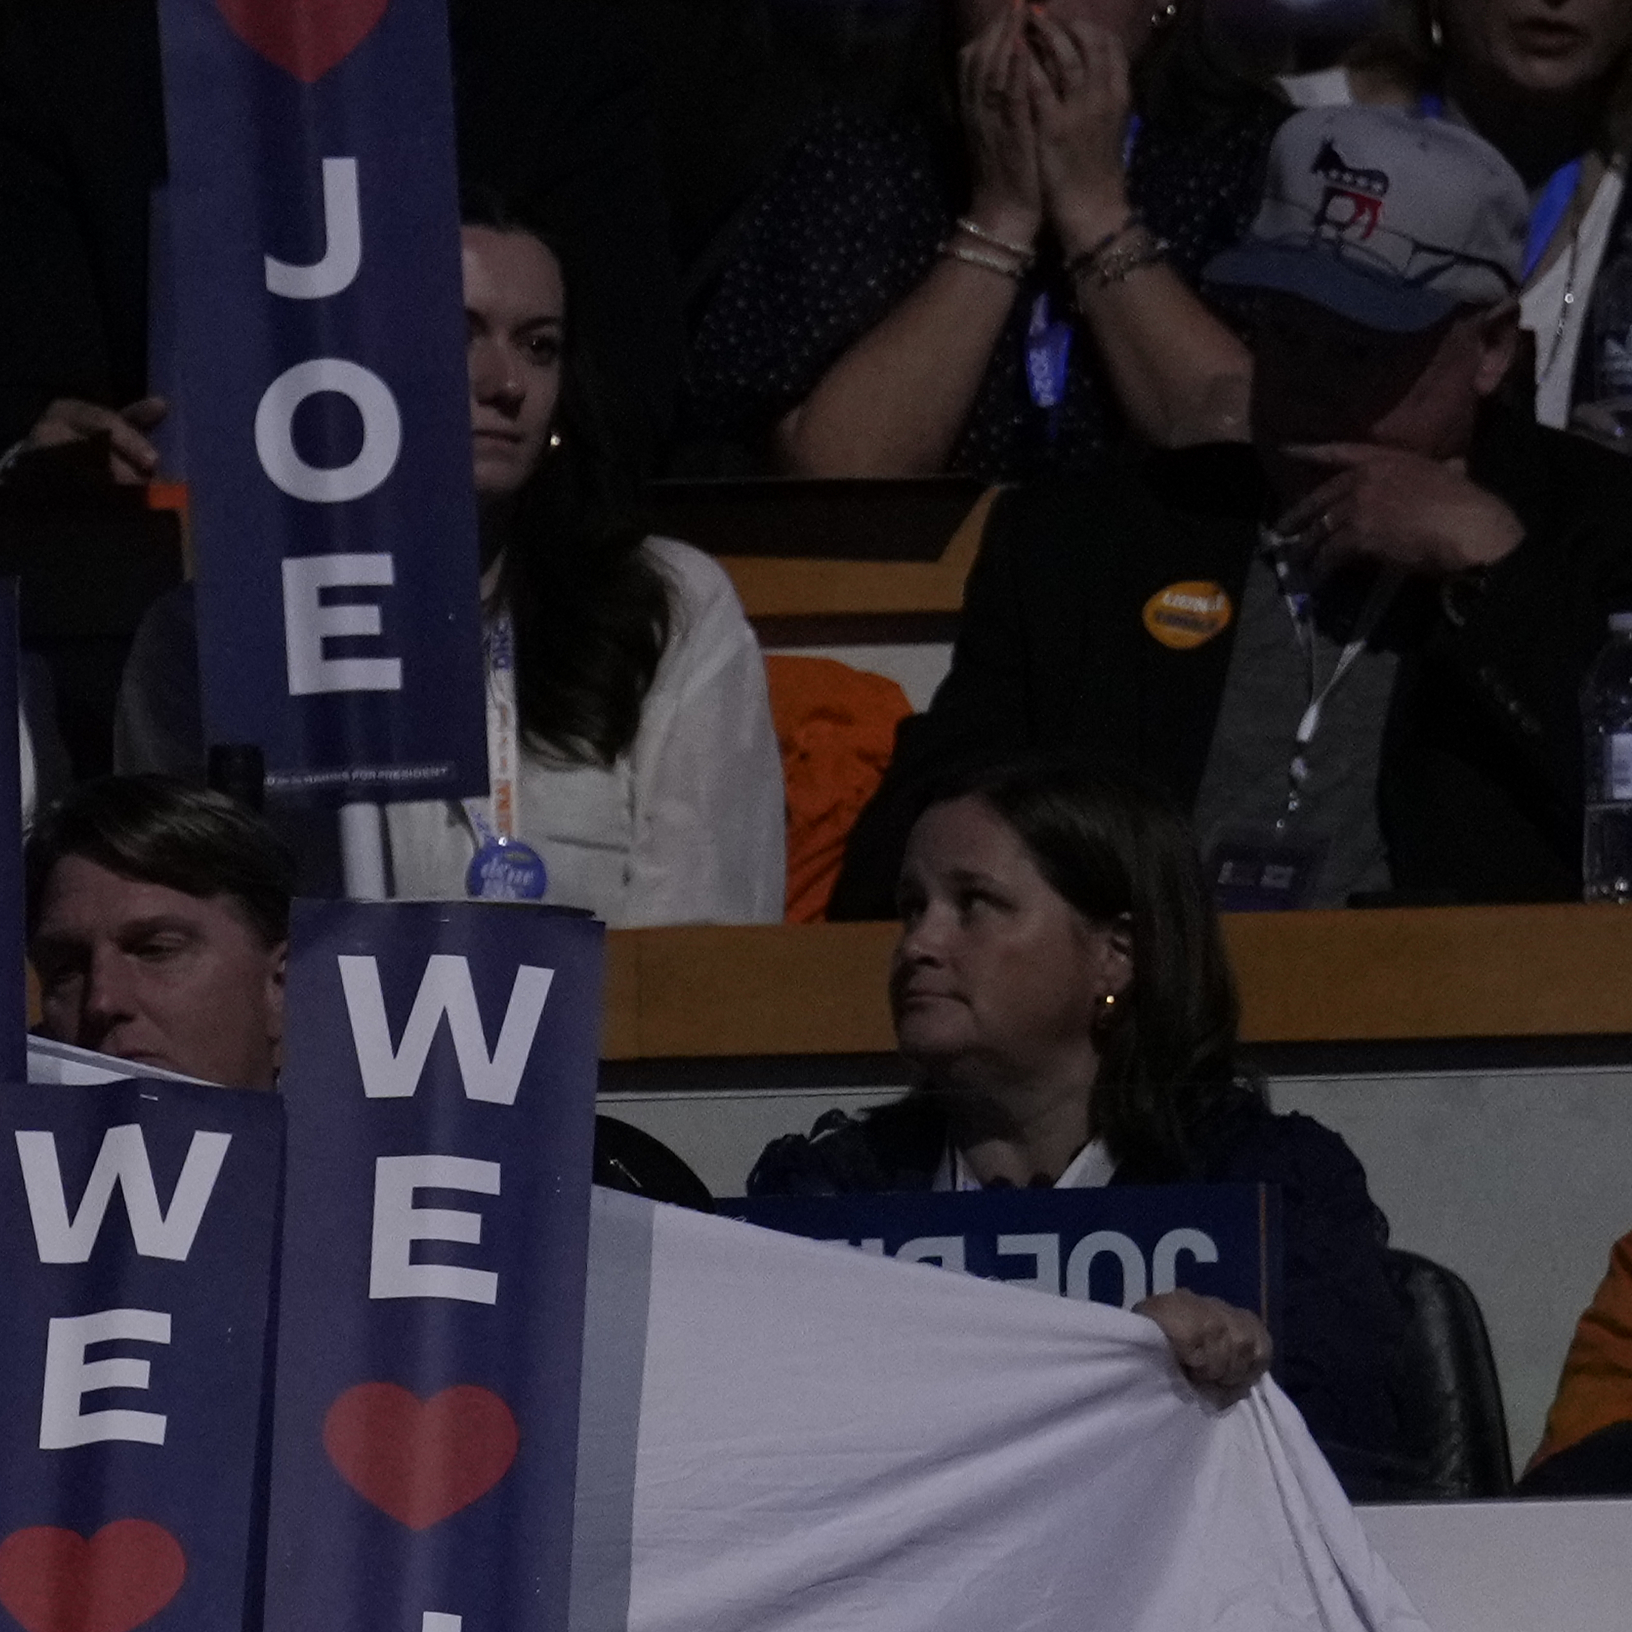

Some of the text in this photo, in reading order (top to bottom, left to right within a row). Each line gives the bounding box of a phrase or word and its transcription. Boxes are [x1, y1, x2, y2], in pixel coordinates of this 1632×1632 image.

[254, 158, 404, 697] JOE
[15, 1123, 232, 1450] WE
[338, 954, 556, 1306] WE
